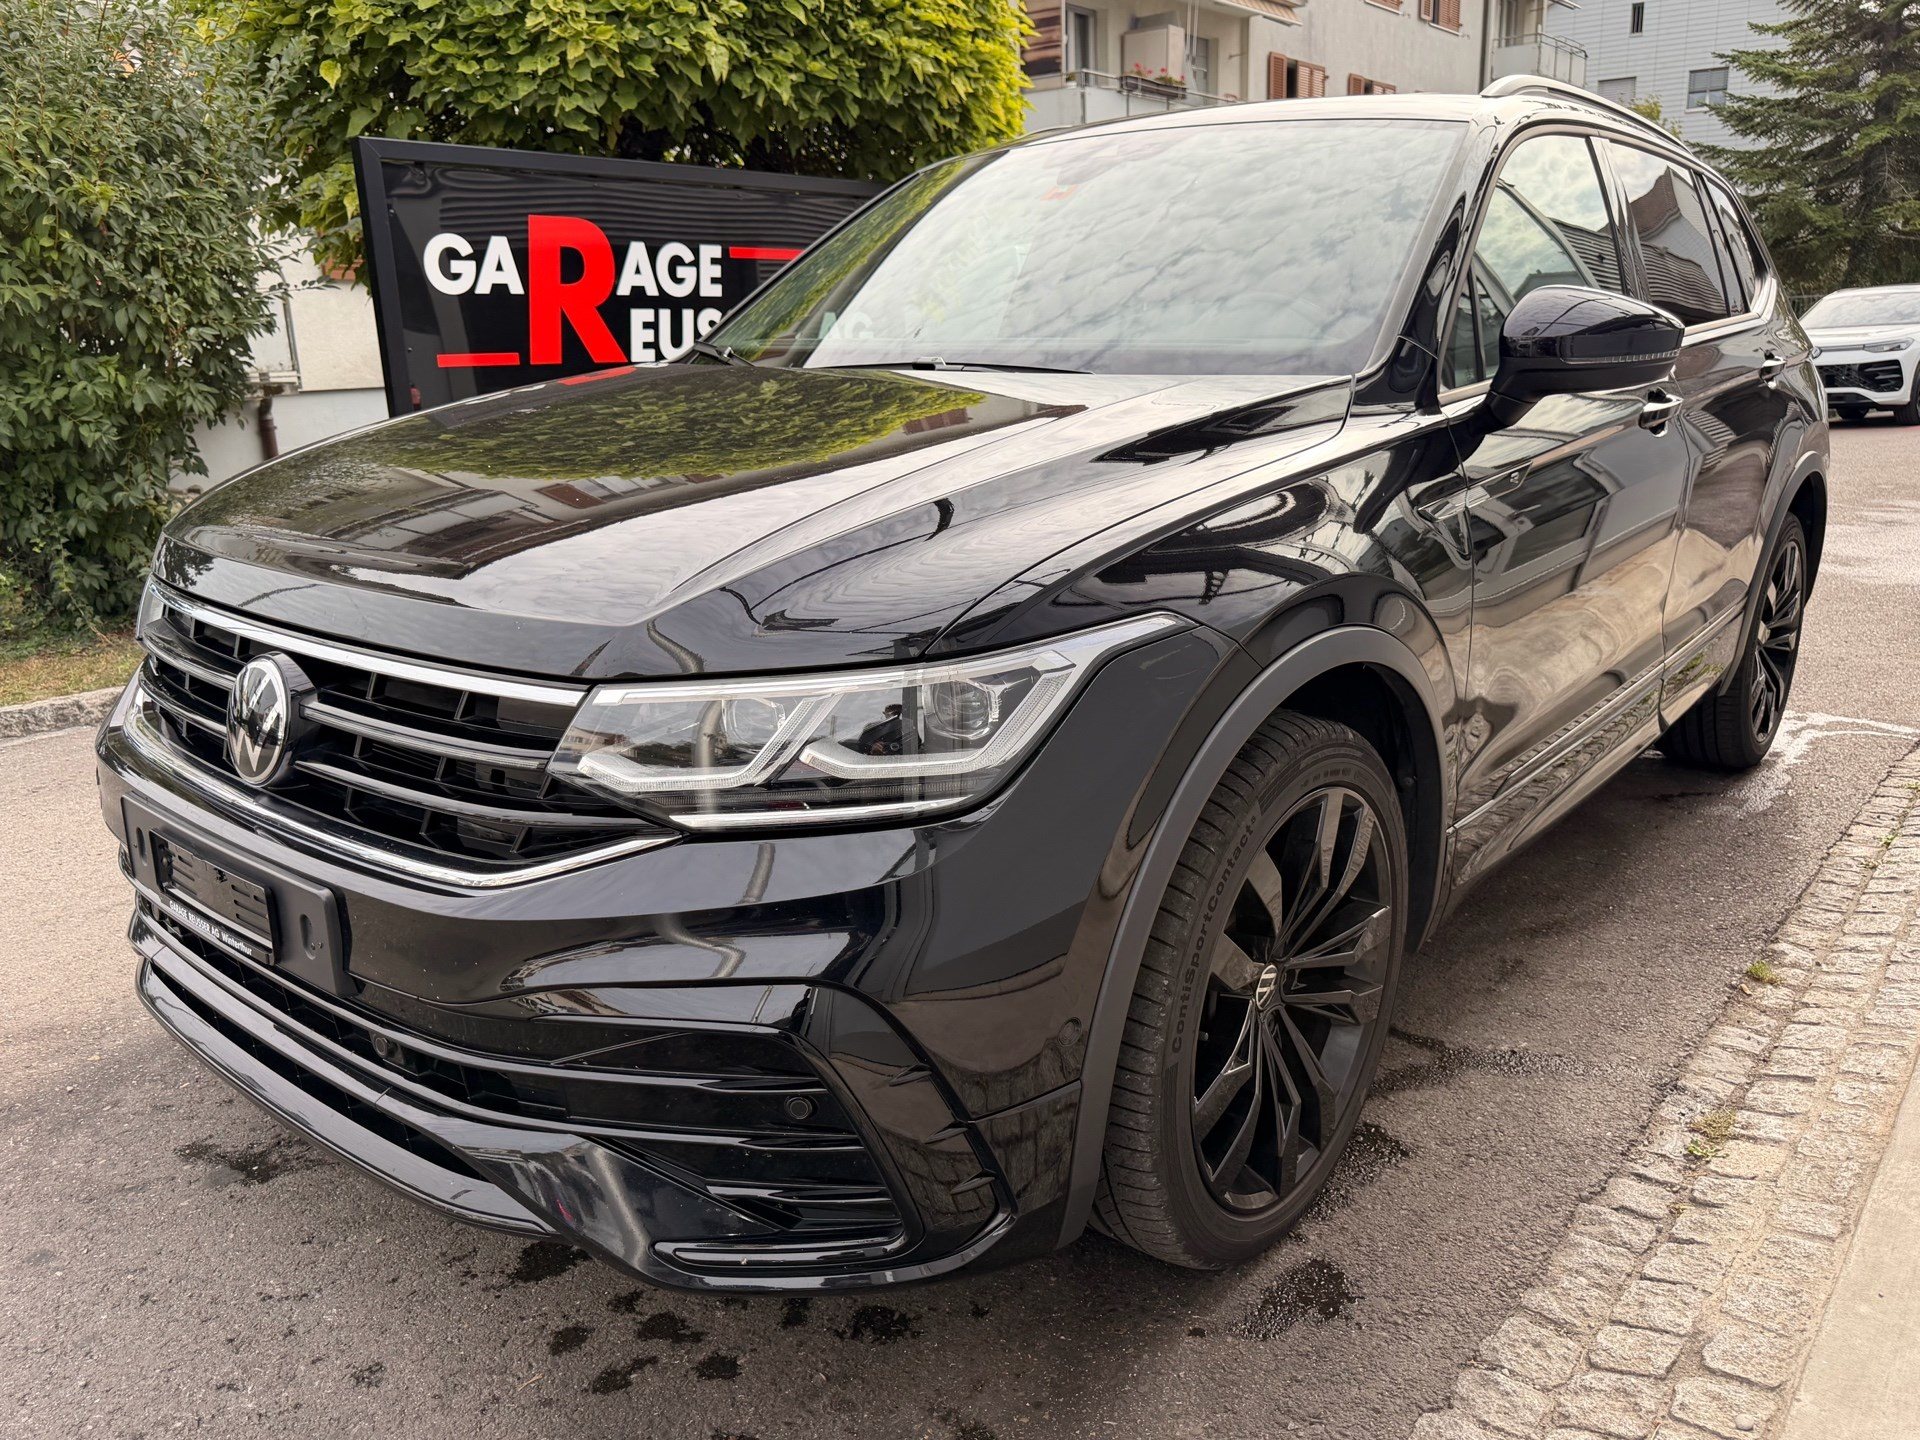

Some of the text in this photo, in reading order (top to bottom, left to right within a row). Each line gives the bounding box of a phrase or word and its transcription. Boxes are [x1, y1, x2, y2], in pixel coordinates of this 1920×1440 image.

[169, 900, 252, 956] GARAGE REUSSER AG Winterthur
[1171, 824, 1254, 1053] ContiSportContact
